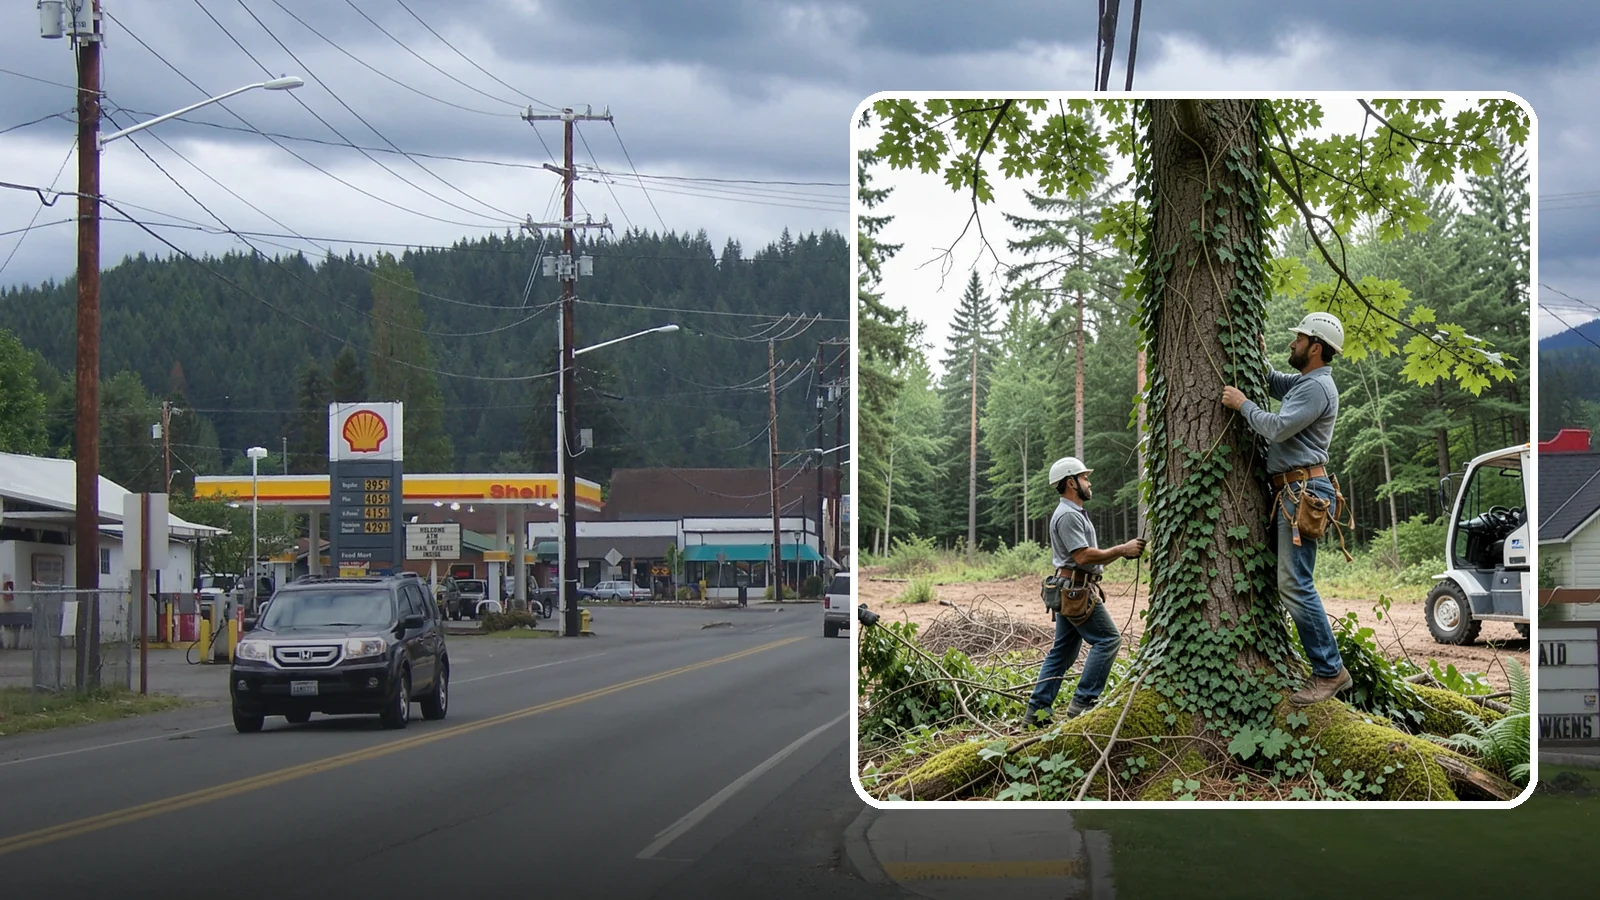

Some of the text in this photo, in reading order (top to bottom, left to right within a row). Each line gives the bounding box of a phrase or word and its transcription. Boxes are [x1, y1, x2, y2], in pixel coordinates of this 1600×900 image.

[366, 480, 384, 490] 395
[490, 484, 547, 499] Shell
[366, 494, 384, 504] 405
[366, 508, 384, 518] 415
[366, 522, 384, 532] 429
[1539, 643, 1567, 665] AID
